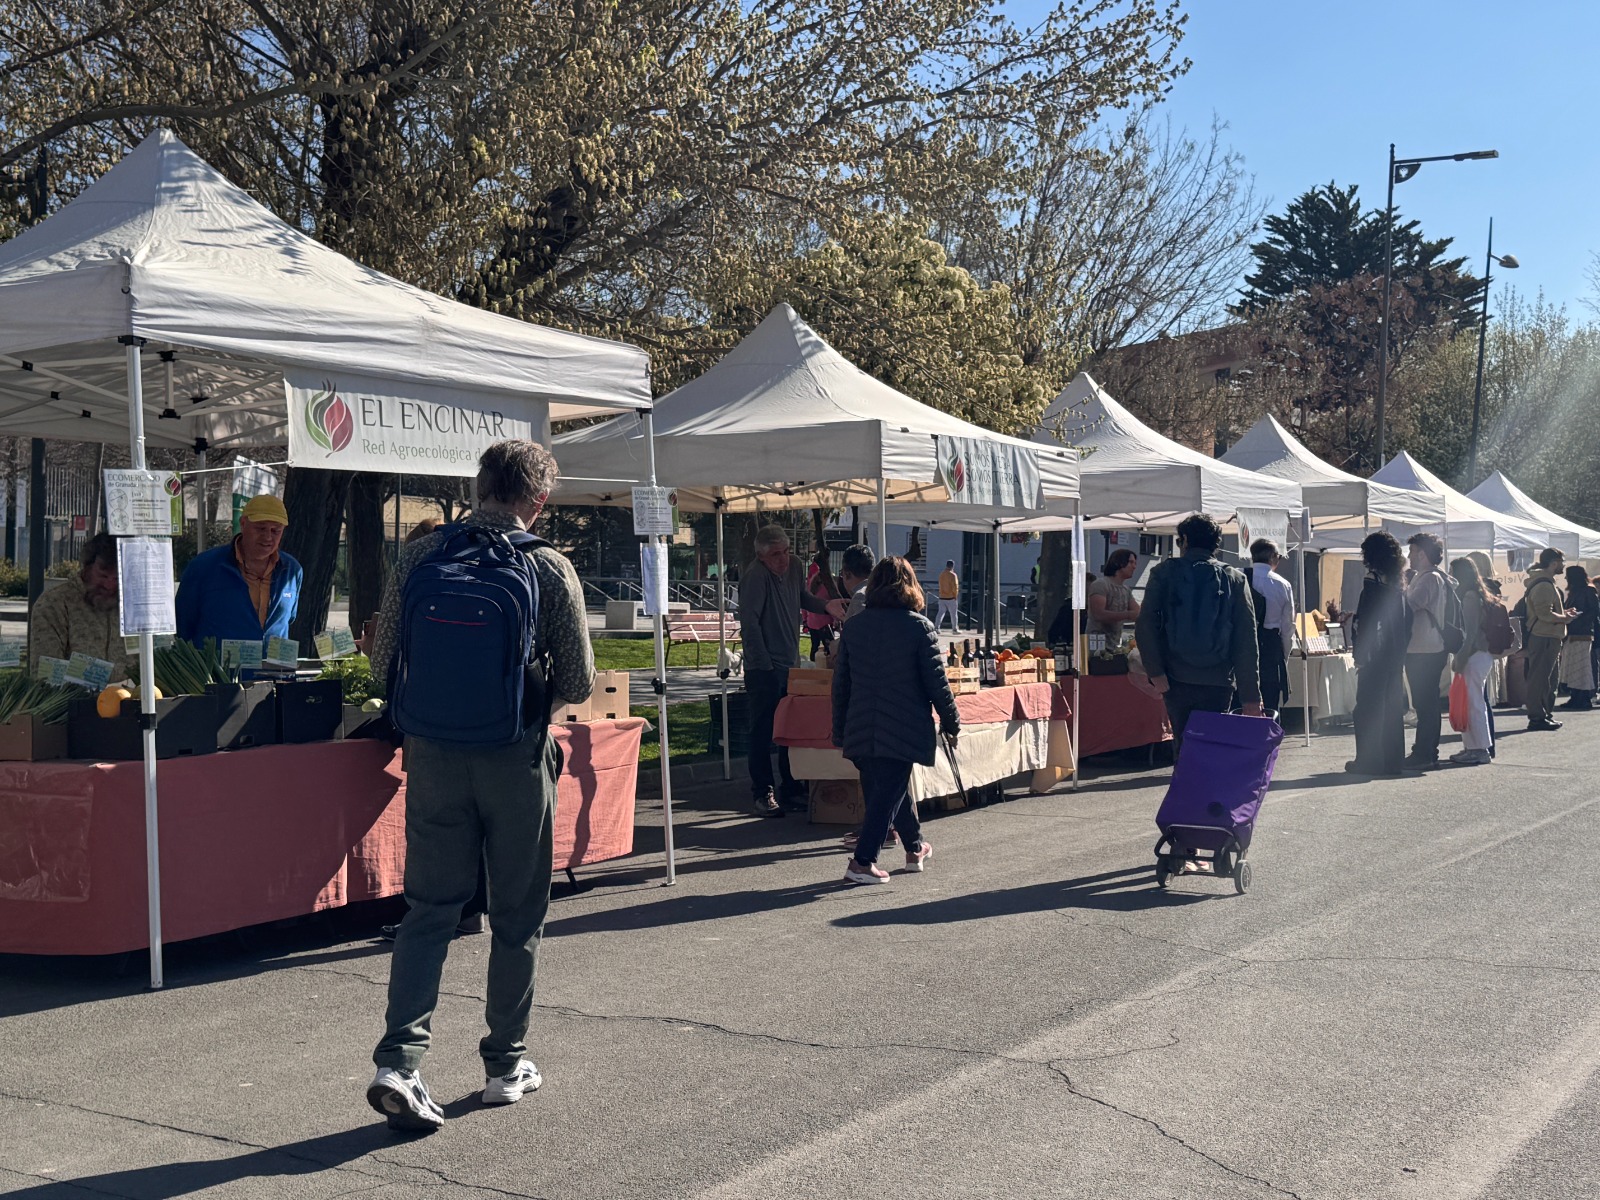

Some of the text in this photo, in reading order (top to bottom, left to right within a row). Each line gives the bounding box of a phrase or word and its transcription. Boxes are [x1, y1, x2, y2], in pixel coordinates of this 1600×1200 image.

[360, 398, 507, 438] EL ENCINAR
[362, 438, 385, 456] Red
[389, 441, 472, 464] Agroecológica
[964, 451, 990, 468] SOMOS
[966, 468, 1021, 486] SOMOS TIERRA
